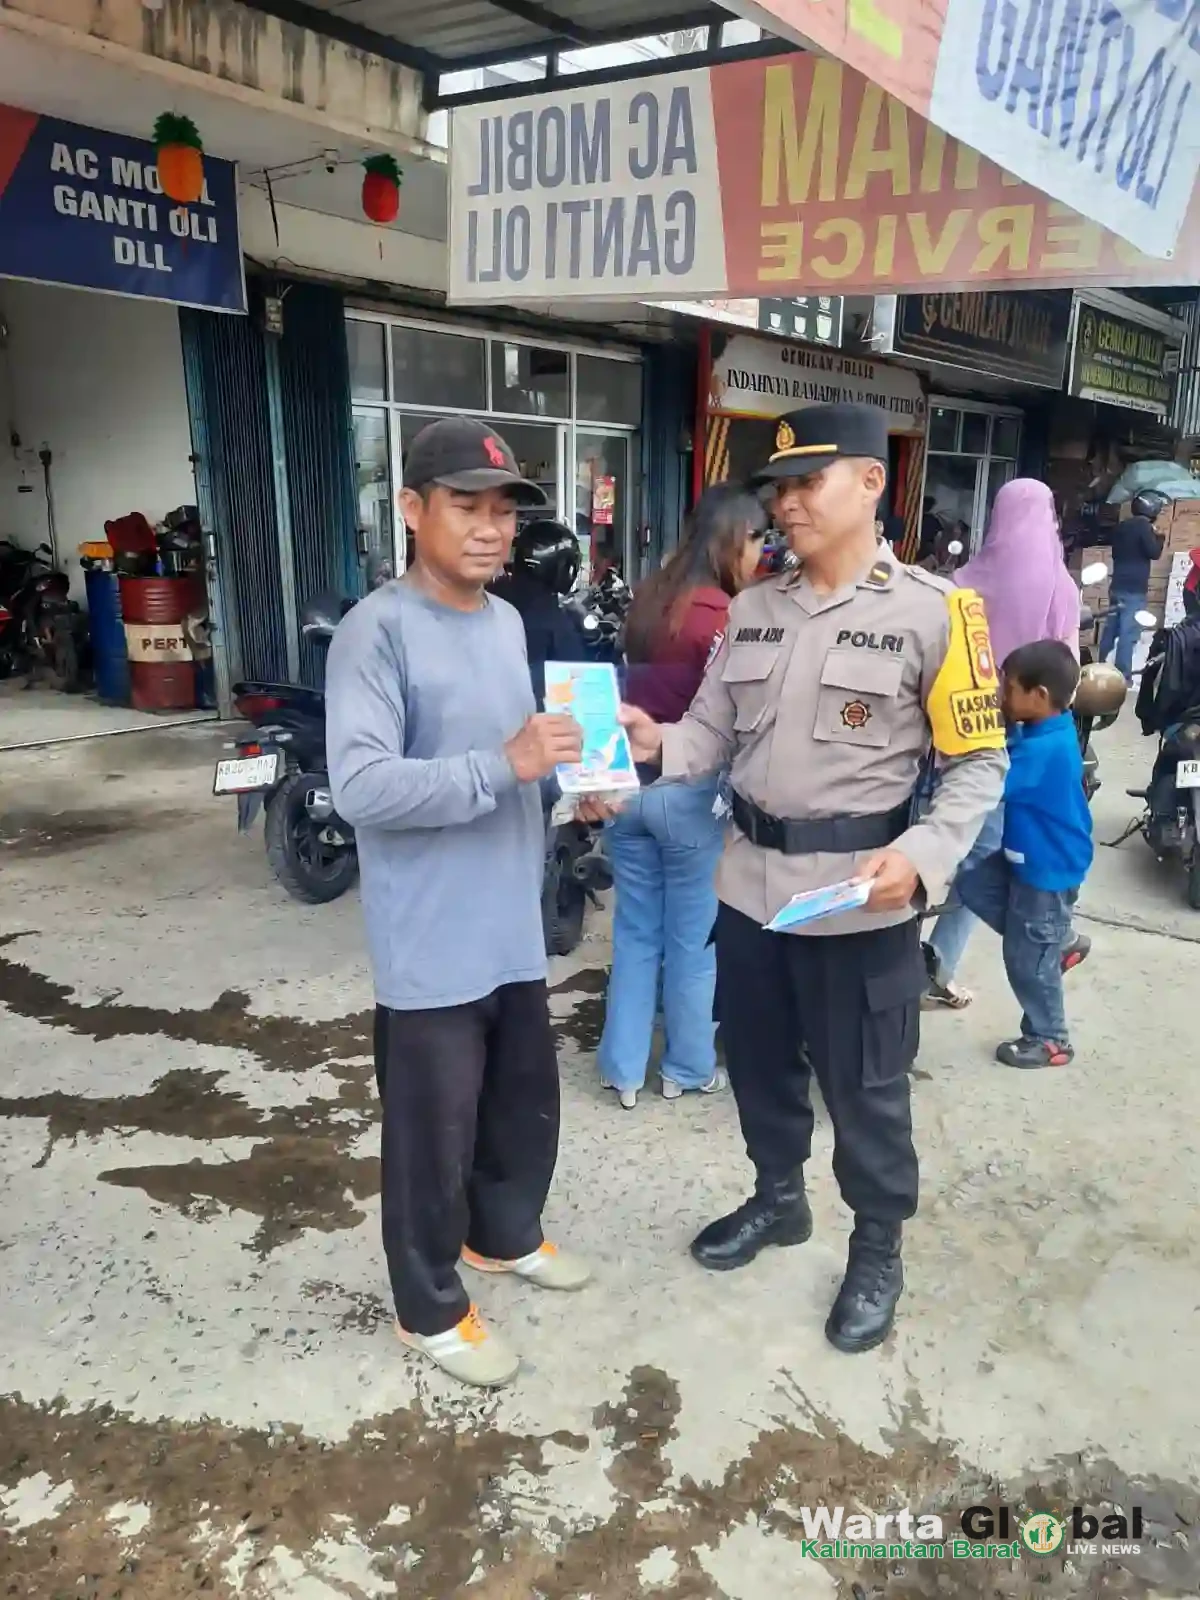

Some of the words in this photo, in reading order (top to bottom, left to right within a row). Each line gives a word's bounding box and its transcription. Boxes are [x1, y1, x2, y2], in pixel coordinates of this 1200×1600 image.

[49, 142, 99, 180] AC
[111, 156, 216, 208] MOL
[53, 184, 158, 233] GANTI
[169, 205, 218, 244] OLI
[114, 236, 173, 273] DLL
[727, 369, 789, 398] INDAHNYA
[836, 629, 905, 653] POLRI
